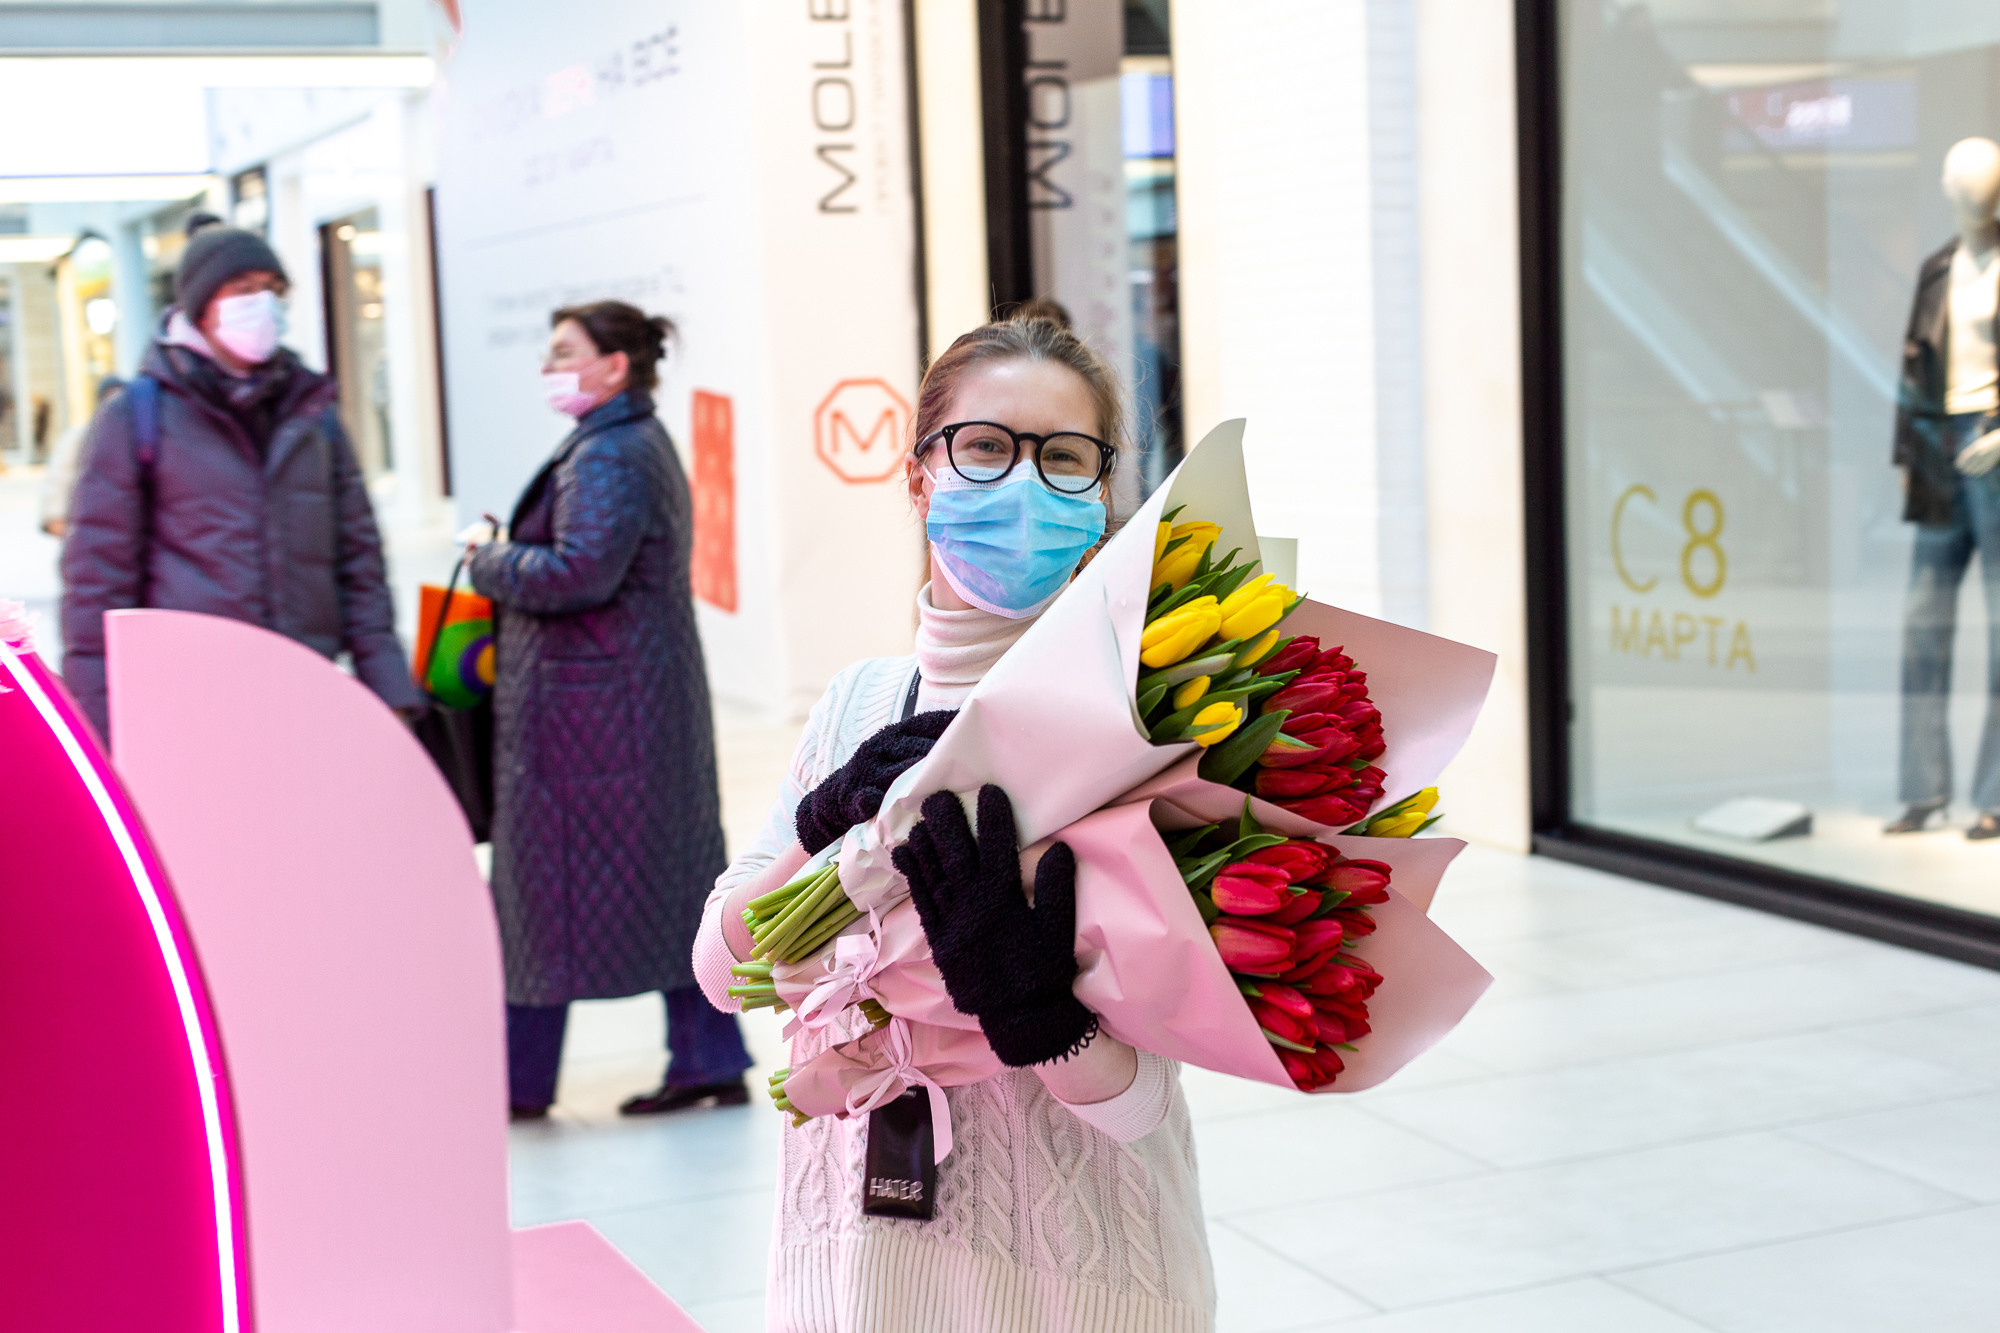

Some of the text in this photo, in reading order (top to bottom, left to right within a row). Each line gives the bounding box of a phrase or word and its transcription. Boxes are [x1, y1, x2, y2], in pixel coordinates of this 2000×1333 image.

[830, 408, 898, 454] M
[1609, 482, 1727, 599] С 8
[1610, 604, 1758, 674] МАРТА
[869, 1177, 924, 1202] HATER
